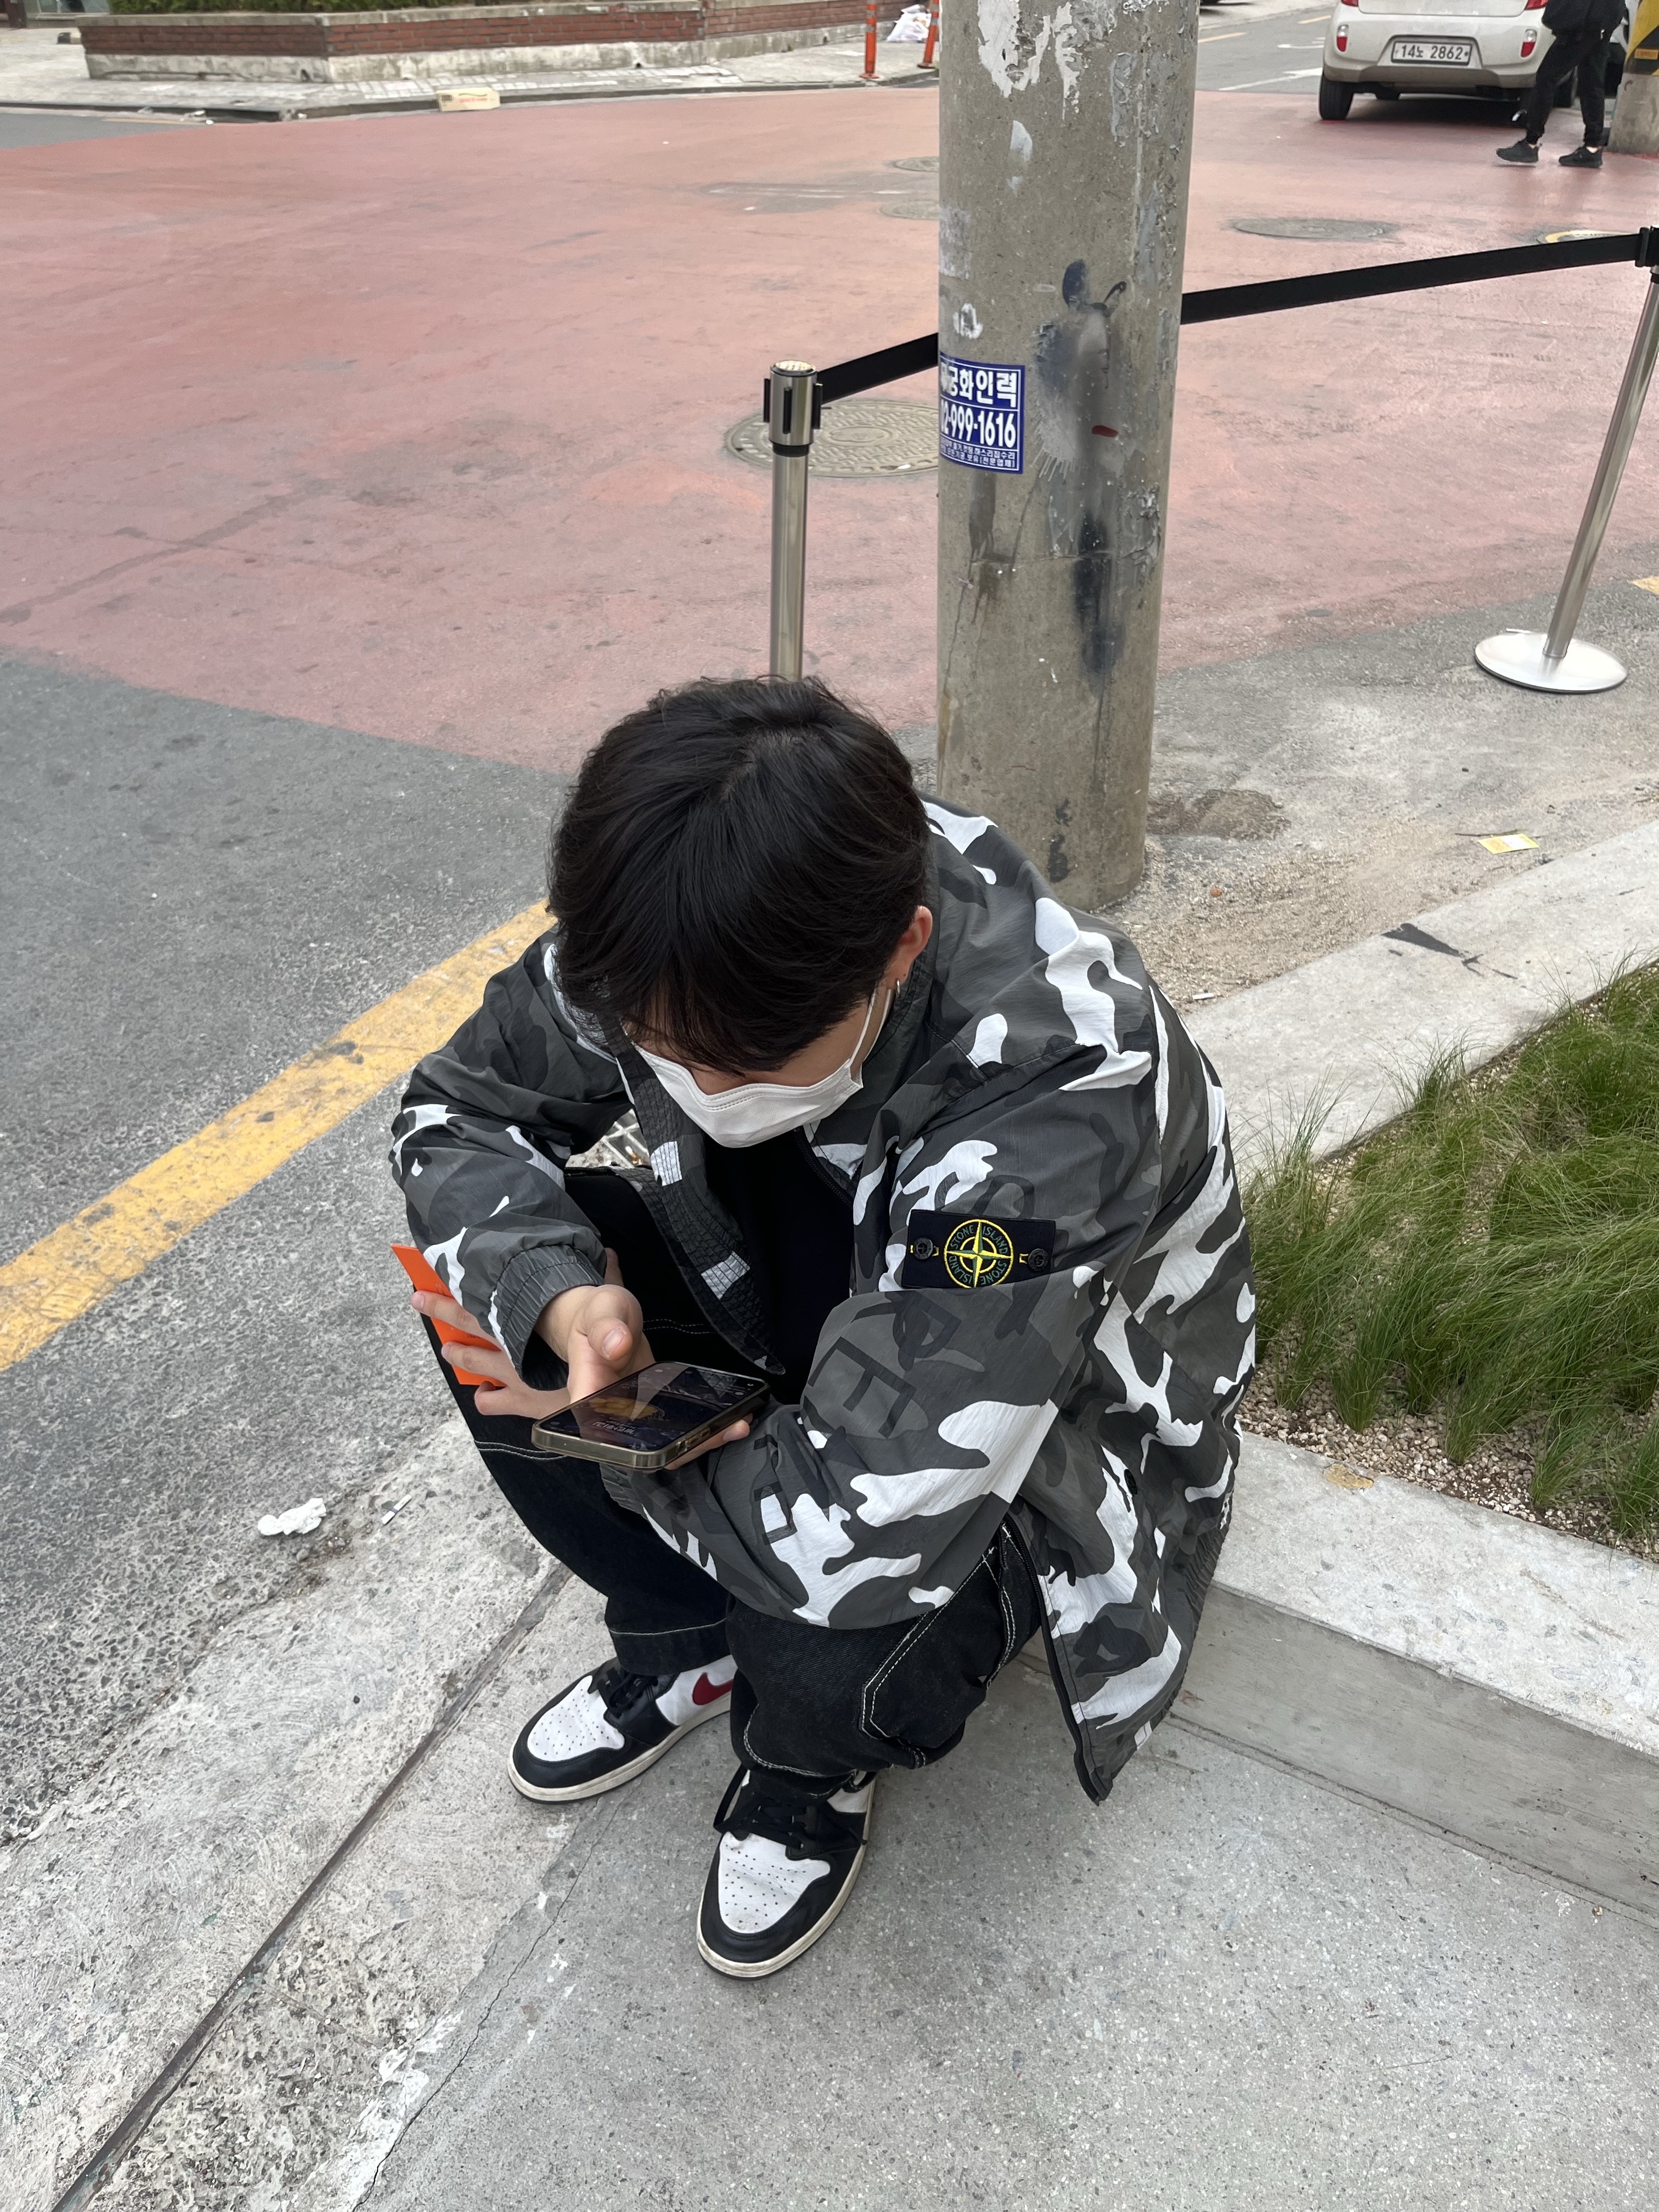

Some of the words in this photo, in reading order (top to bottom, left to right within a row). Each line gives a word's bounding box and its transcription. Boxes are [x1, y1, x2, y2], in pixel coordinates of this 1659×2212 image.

[1402, 44, 1424, 58] 14노
[1430, 46, 1463, 60] 2862
[950, 1224, 974, 1249] STONE
[981, 1225, 1008, 1254] ISLAND
[949, 1255, 973, 1285] ISLAND
[979, 1260, 1007, 1285] STONE
